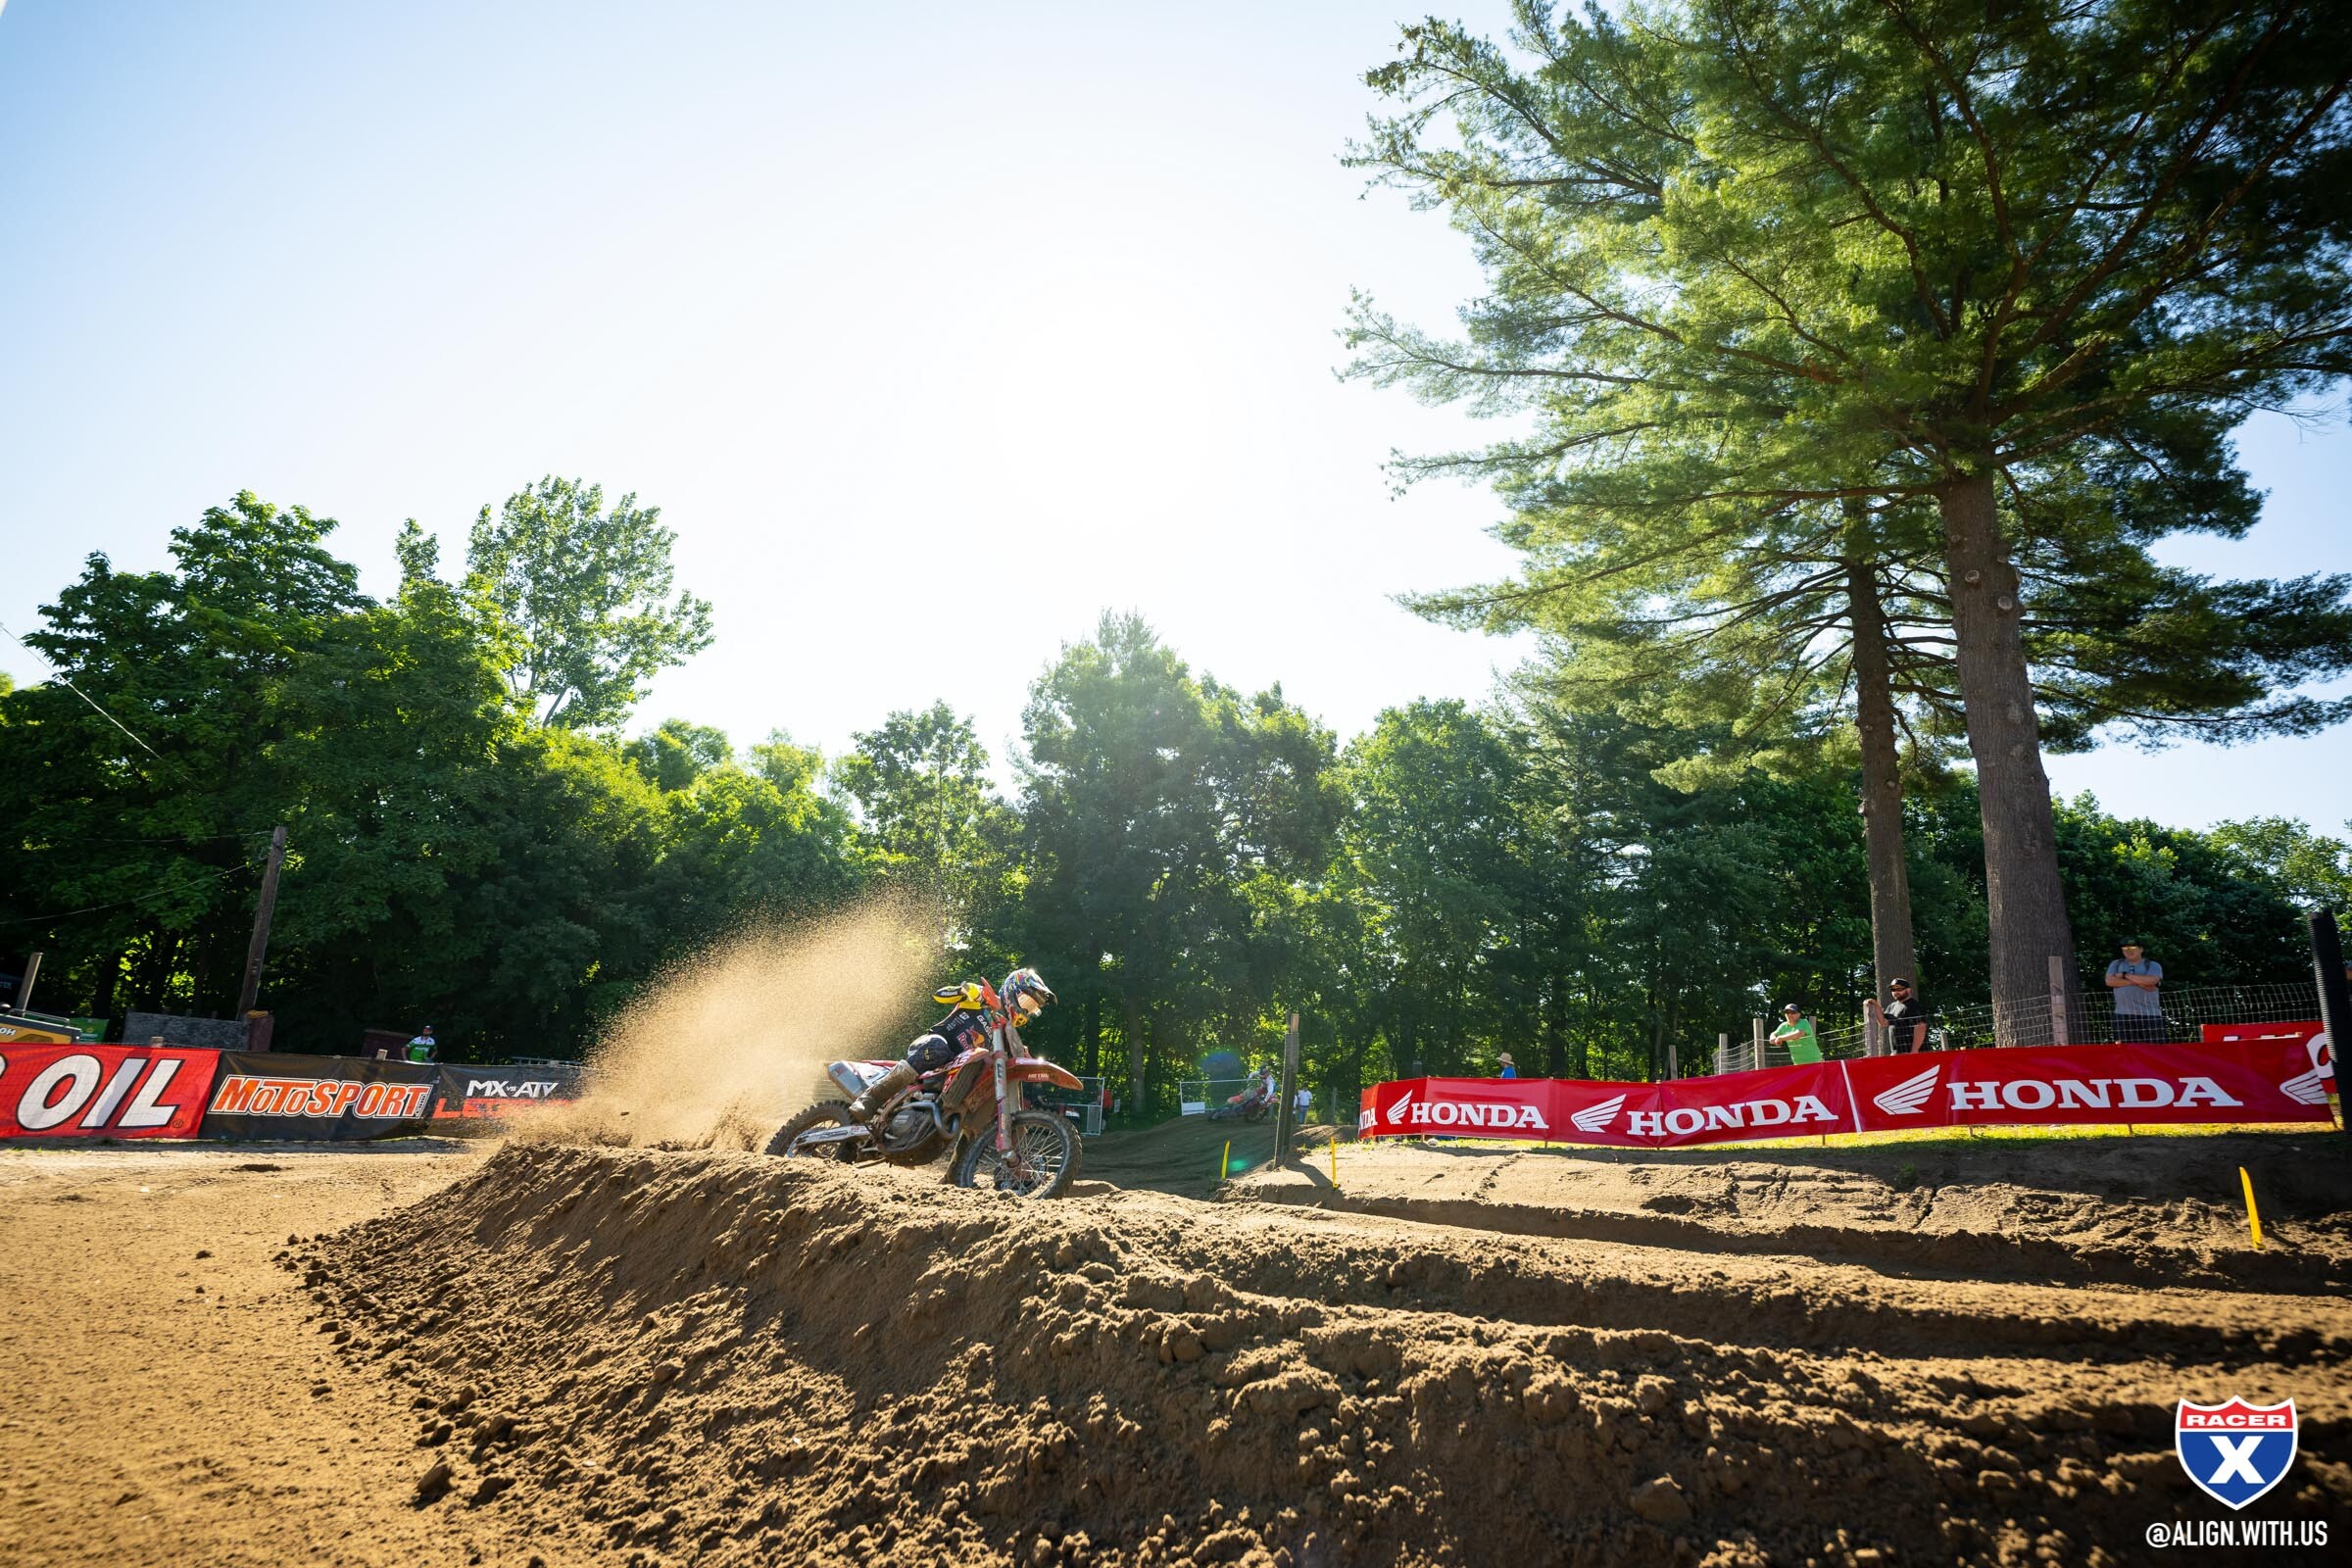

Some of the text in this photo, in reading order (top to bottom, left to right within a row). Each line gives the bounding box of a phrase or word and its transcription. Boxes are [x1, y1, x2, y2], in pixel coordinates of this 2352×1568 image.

[16, 1054, 185, 1131] OIL
[466, 1080, 509, 1097] MX
[513, 1081, 559, 1098] ATV
[1946, 1077, 2244, 1110] HONDA
[1411, 1102, 1549, 1129] HONDA
[1627, 1095, 1838, 1137] HONDA
